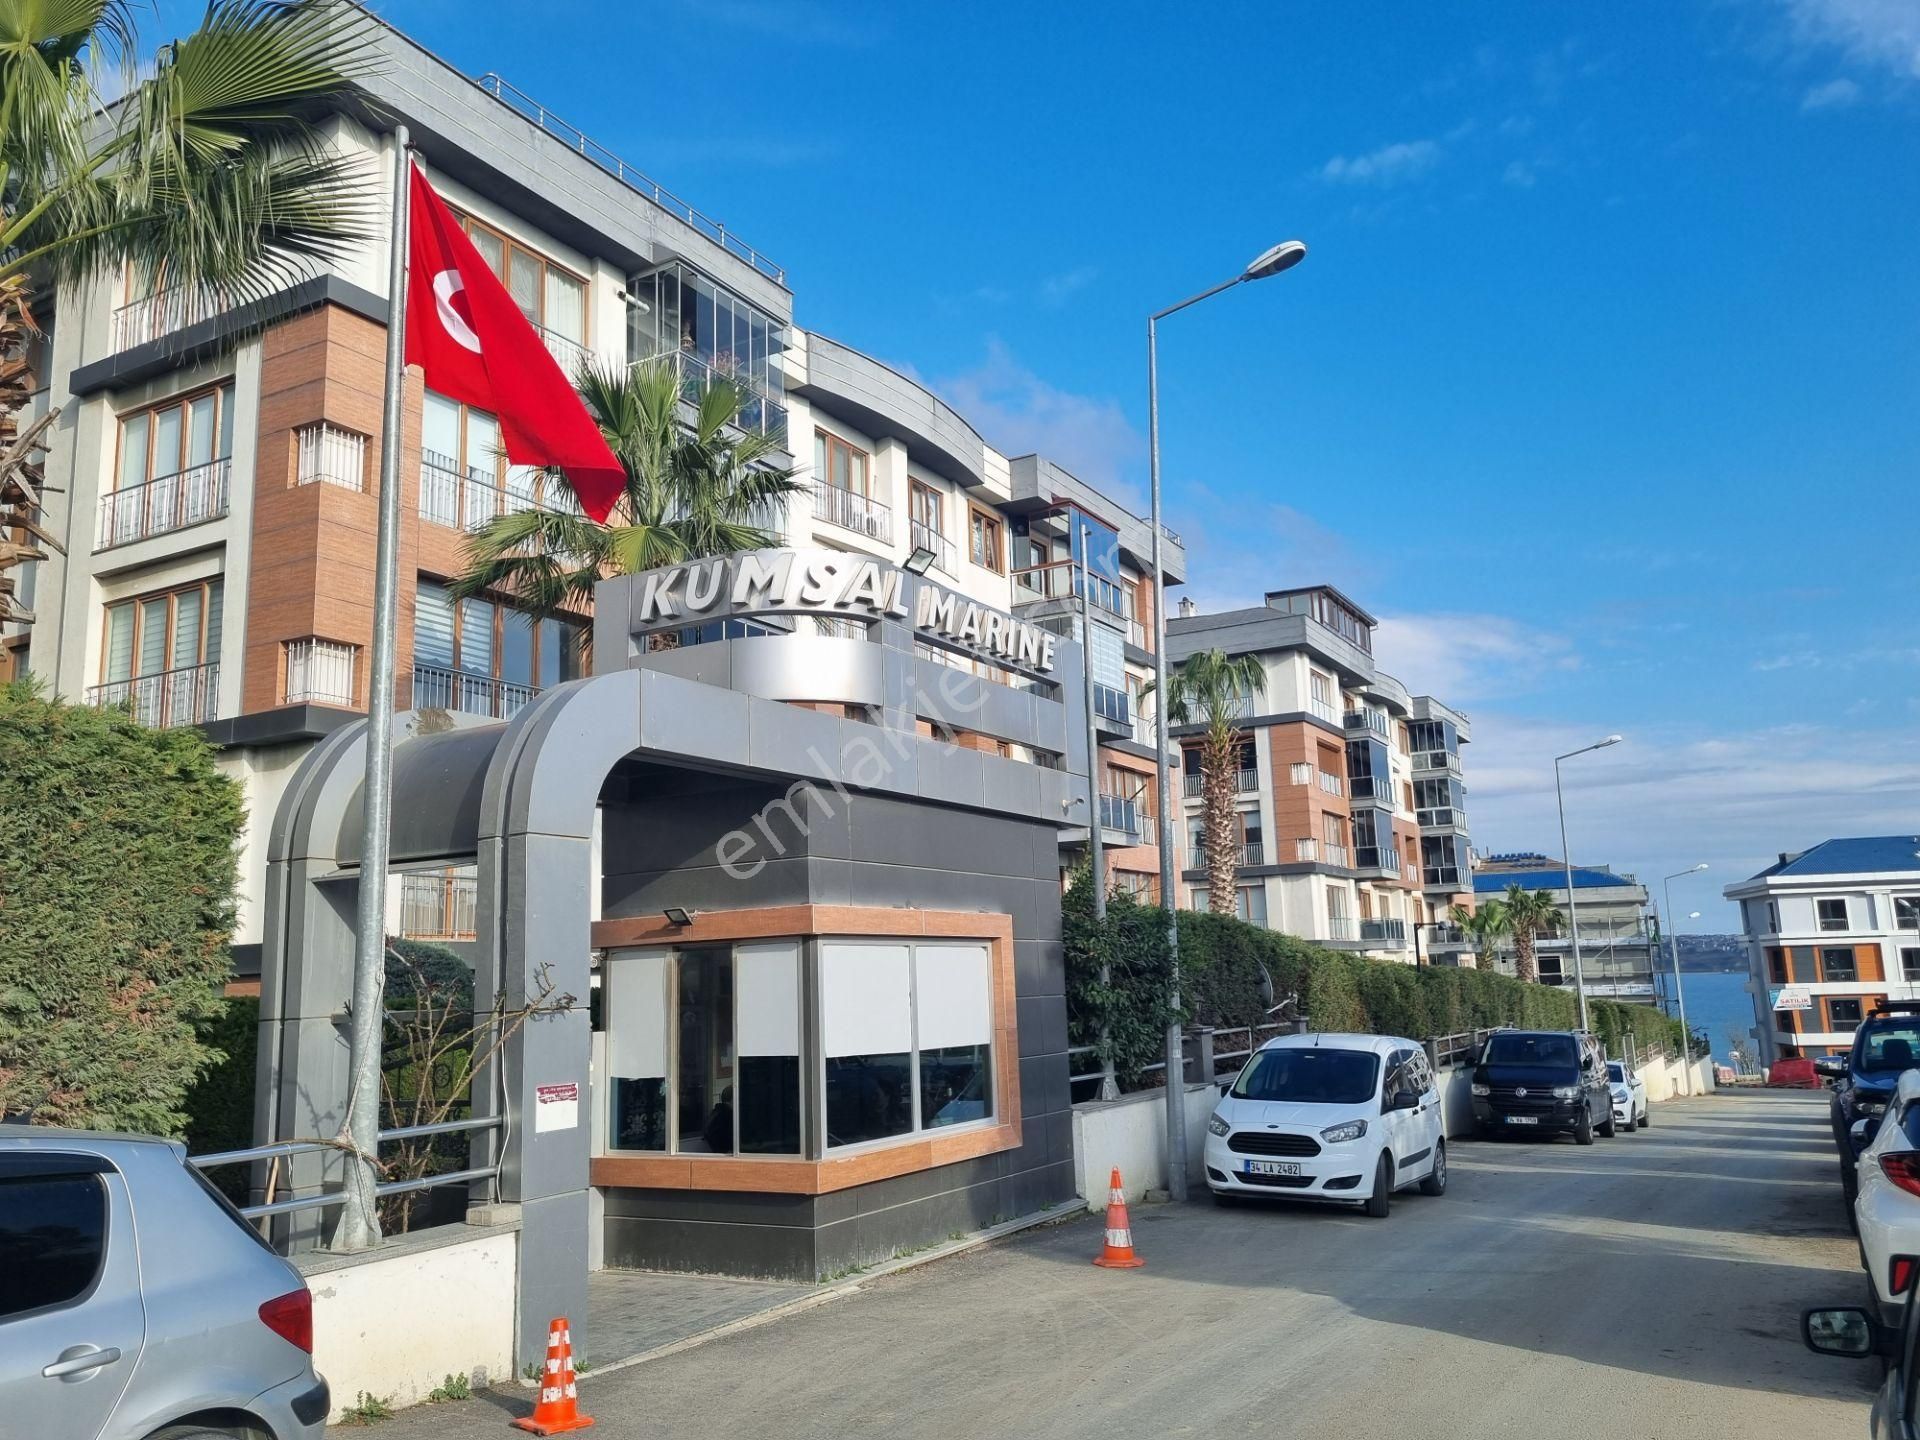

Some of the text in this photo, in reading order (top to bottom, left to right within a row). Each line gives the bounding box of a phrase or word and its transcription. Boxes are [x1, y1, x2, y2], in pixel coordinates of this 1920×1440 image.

[640, 552, 1056, 673] KUMSAL MARINE
[1251, 1162, 1298, 1175] 34 LA 2482
